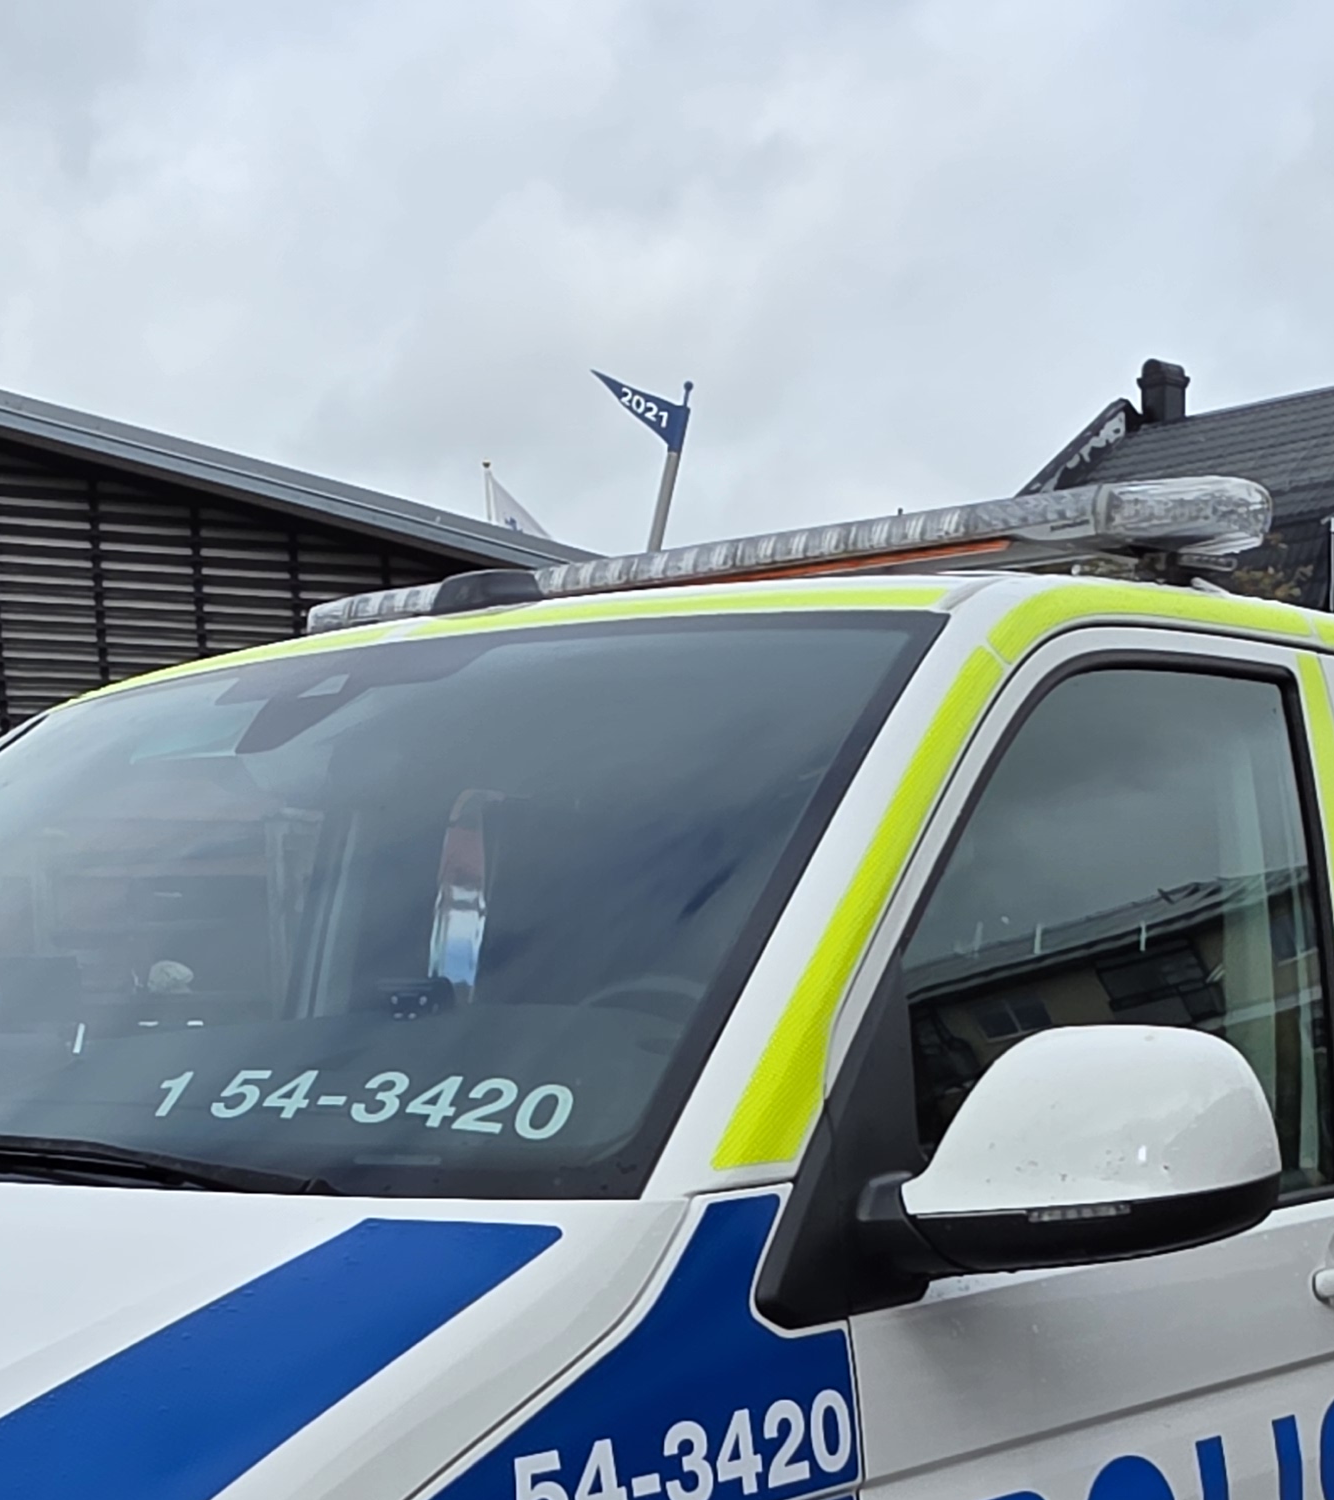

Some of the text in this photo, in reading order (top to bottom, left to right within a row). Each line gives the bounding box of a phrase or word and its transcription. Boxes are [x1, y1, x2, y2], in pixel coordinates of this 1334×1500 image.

[620, 387, 669, 428] 2021
[155, 1069, 574, 1140] 1 54-3420
